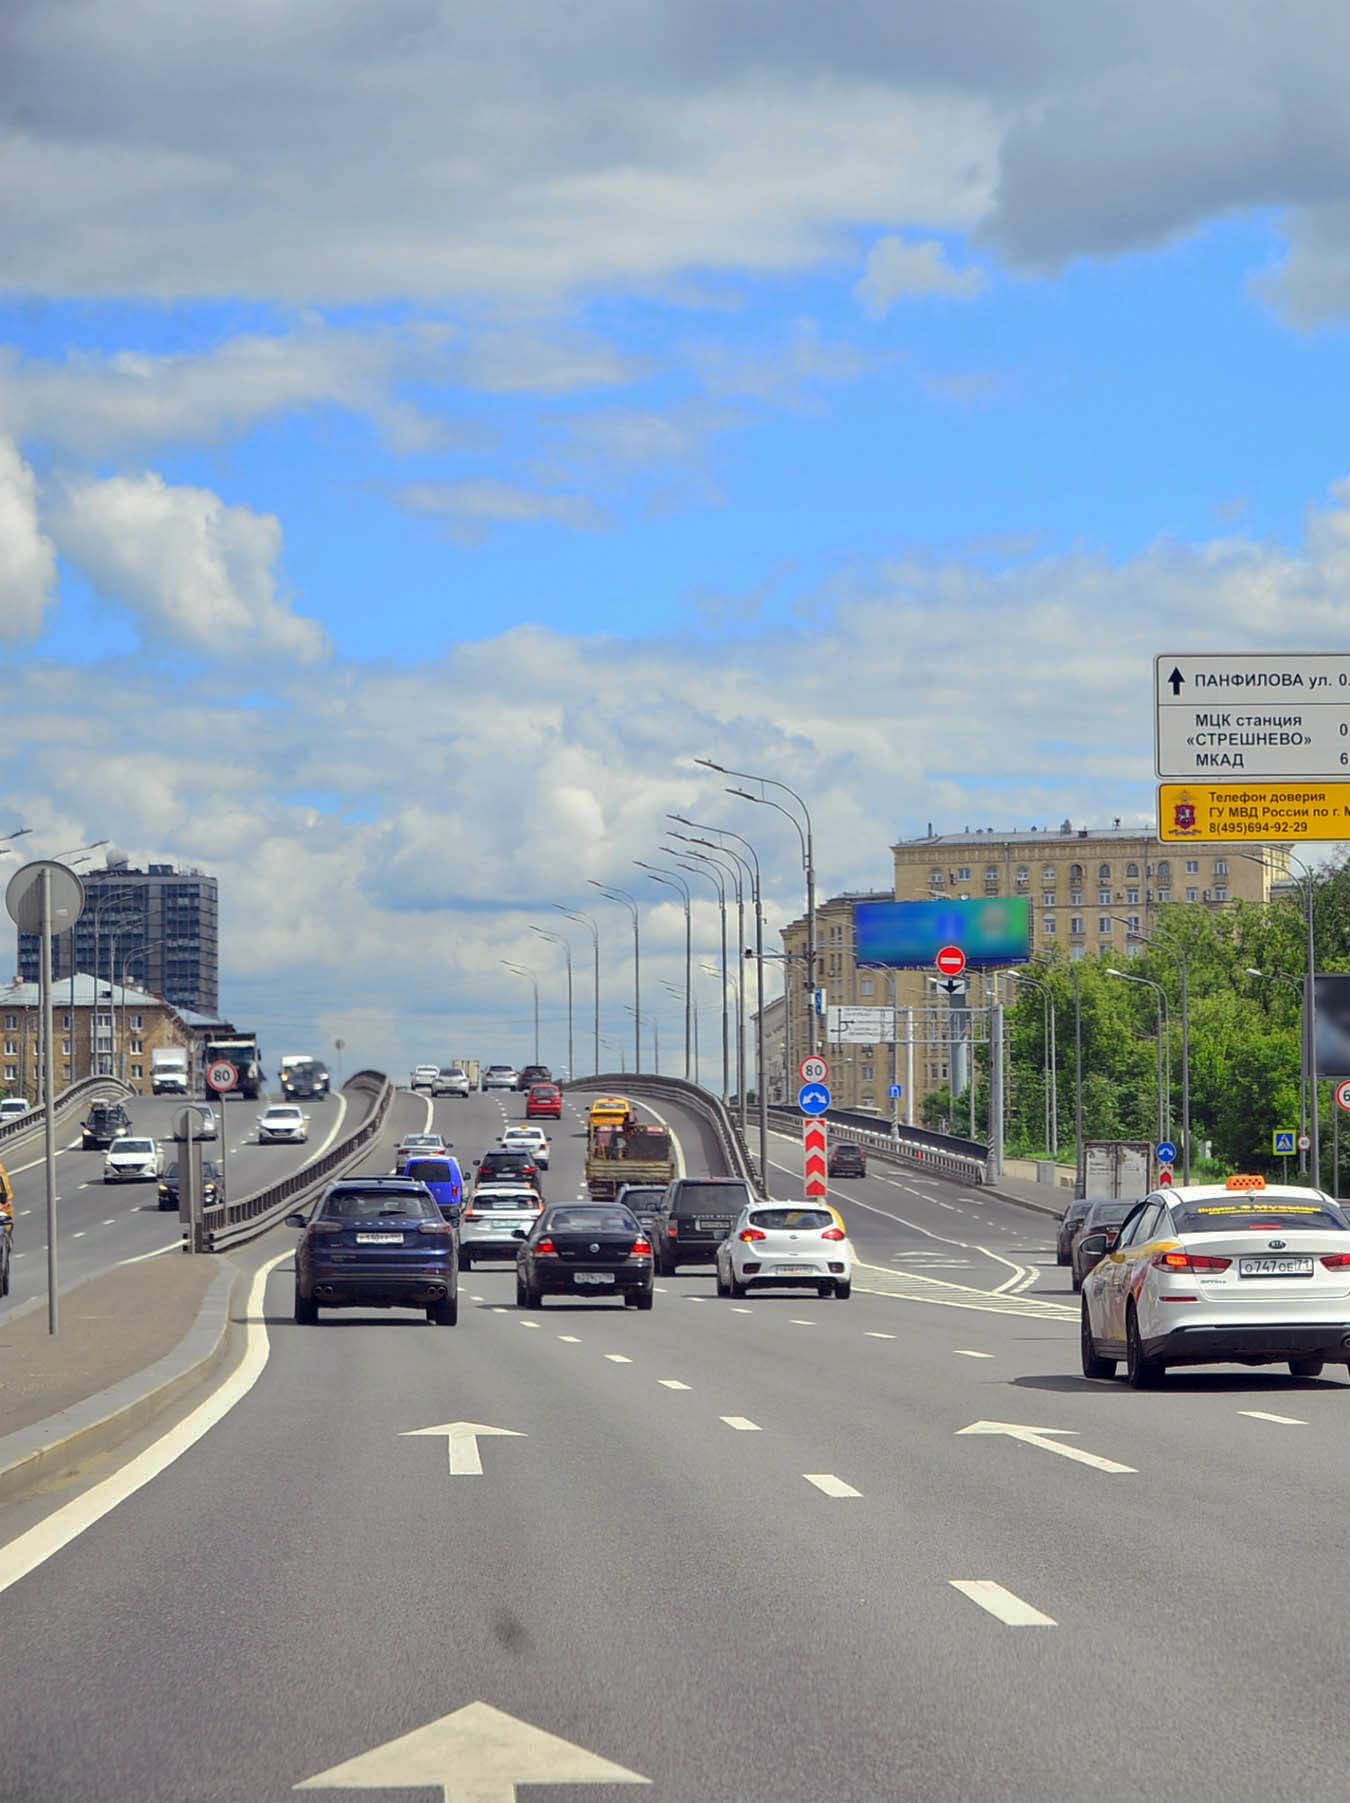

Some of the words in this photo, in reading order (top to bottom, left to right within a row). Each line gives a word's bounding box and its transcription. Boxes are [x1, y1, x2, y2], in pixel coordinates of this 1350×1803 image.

[1194, 673, 1304, 687] ПАНФИЛОВА
[1308, 675, 1332, 689] ул.
[1195, 713, 1232, 729] МЦК
[1236, 715, 1303, 729] станция
[1186, 732, 1312, 746] «СТРЕШНЕВО»
[1195, 753, 1245, 768] МКАД
[1208, 791, 1267, 804] Телефон
[1271, 792, 1326, 804] доверия
[1209, 807, 1224, 818] ГУ
[1228, 806, 1259, 819] МВД
[1262, 805, 1309, 817] России
[1313, 807, 1329, 817] по
[1332, 807, 1341, 817] г.
[1208, 821, 1308, 836] 8(495)694-92-29
[214, 1070, 231, 1082] 80
[806, 1064, 823, 1077] 80
